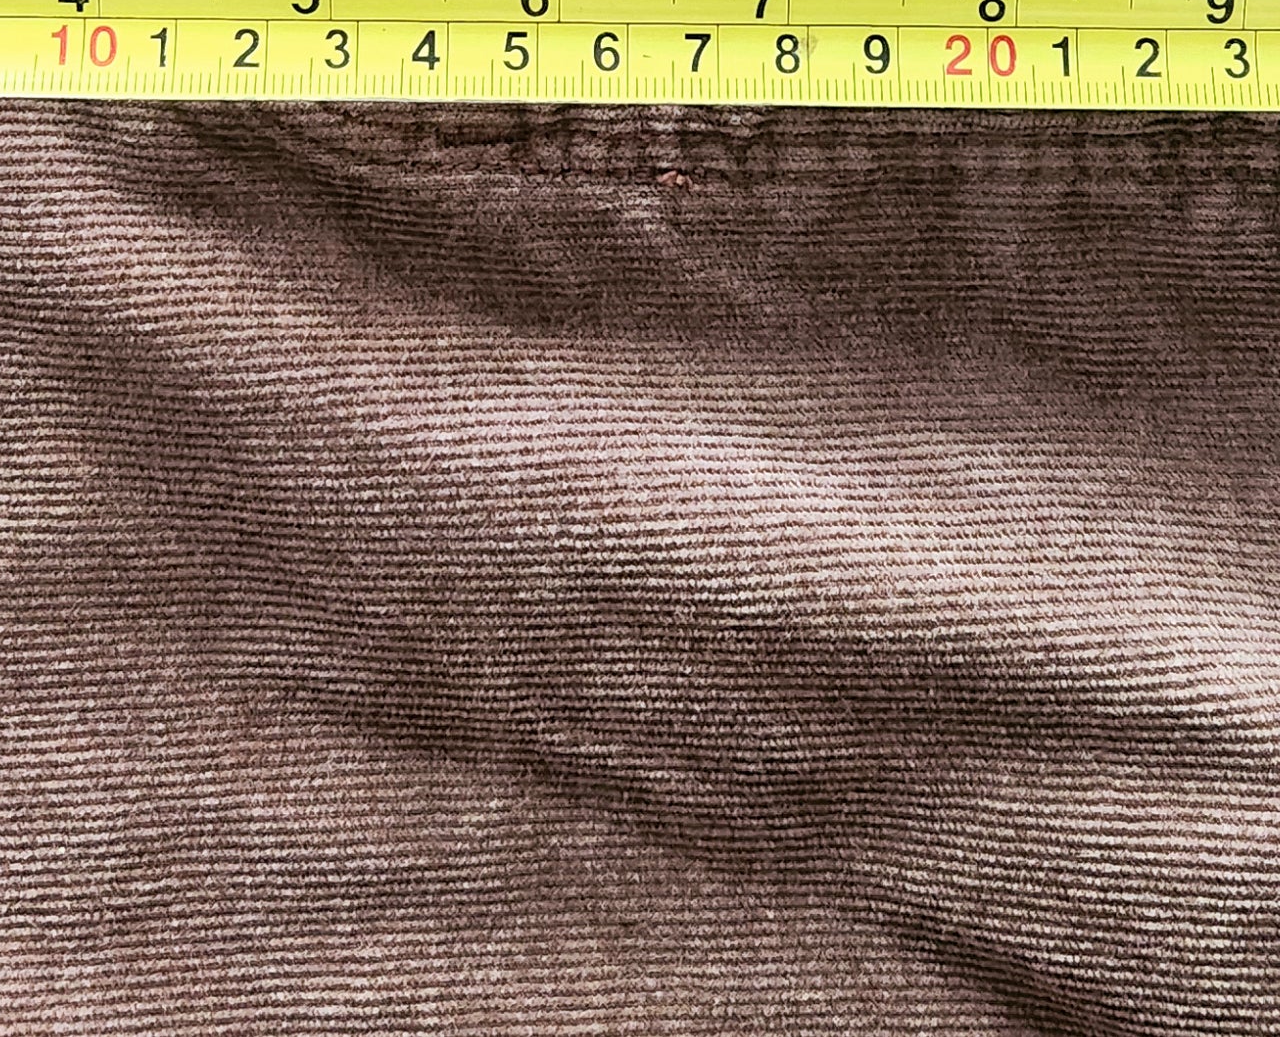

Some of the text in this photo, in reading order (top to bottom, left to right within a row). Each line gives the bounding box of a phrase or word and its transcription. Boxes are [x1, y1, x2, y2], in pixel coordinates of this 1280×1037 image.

[52, 25, 118, 67] 10
[151, 28, 169, 67] 1
[234, 30, 260, 68] 2
[325, 30, 350, 69] 3
[412, 31, 441, 70] 4
[504, 32, 530, 71] 5
[593, 33, 621, 71] 6
[685, 34, 711, 72] 7
[775, 34, 800, 74] 8
[864, 35, 891, 74] 9
[945, 34, 1017, 76] 20
[1052, 37, 1071, 76] 1
[1135, 37, 1162, 76] 2
[1224, 38, 1251, 78] 3
